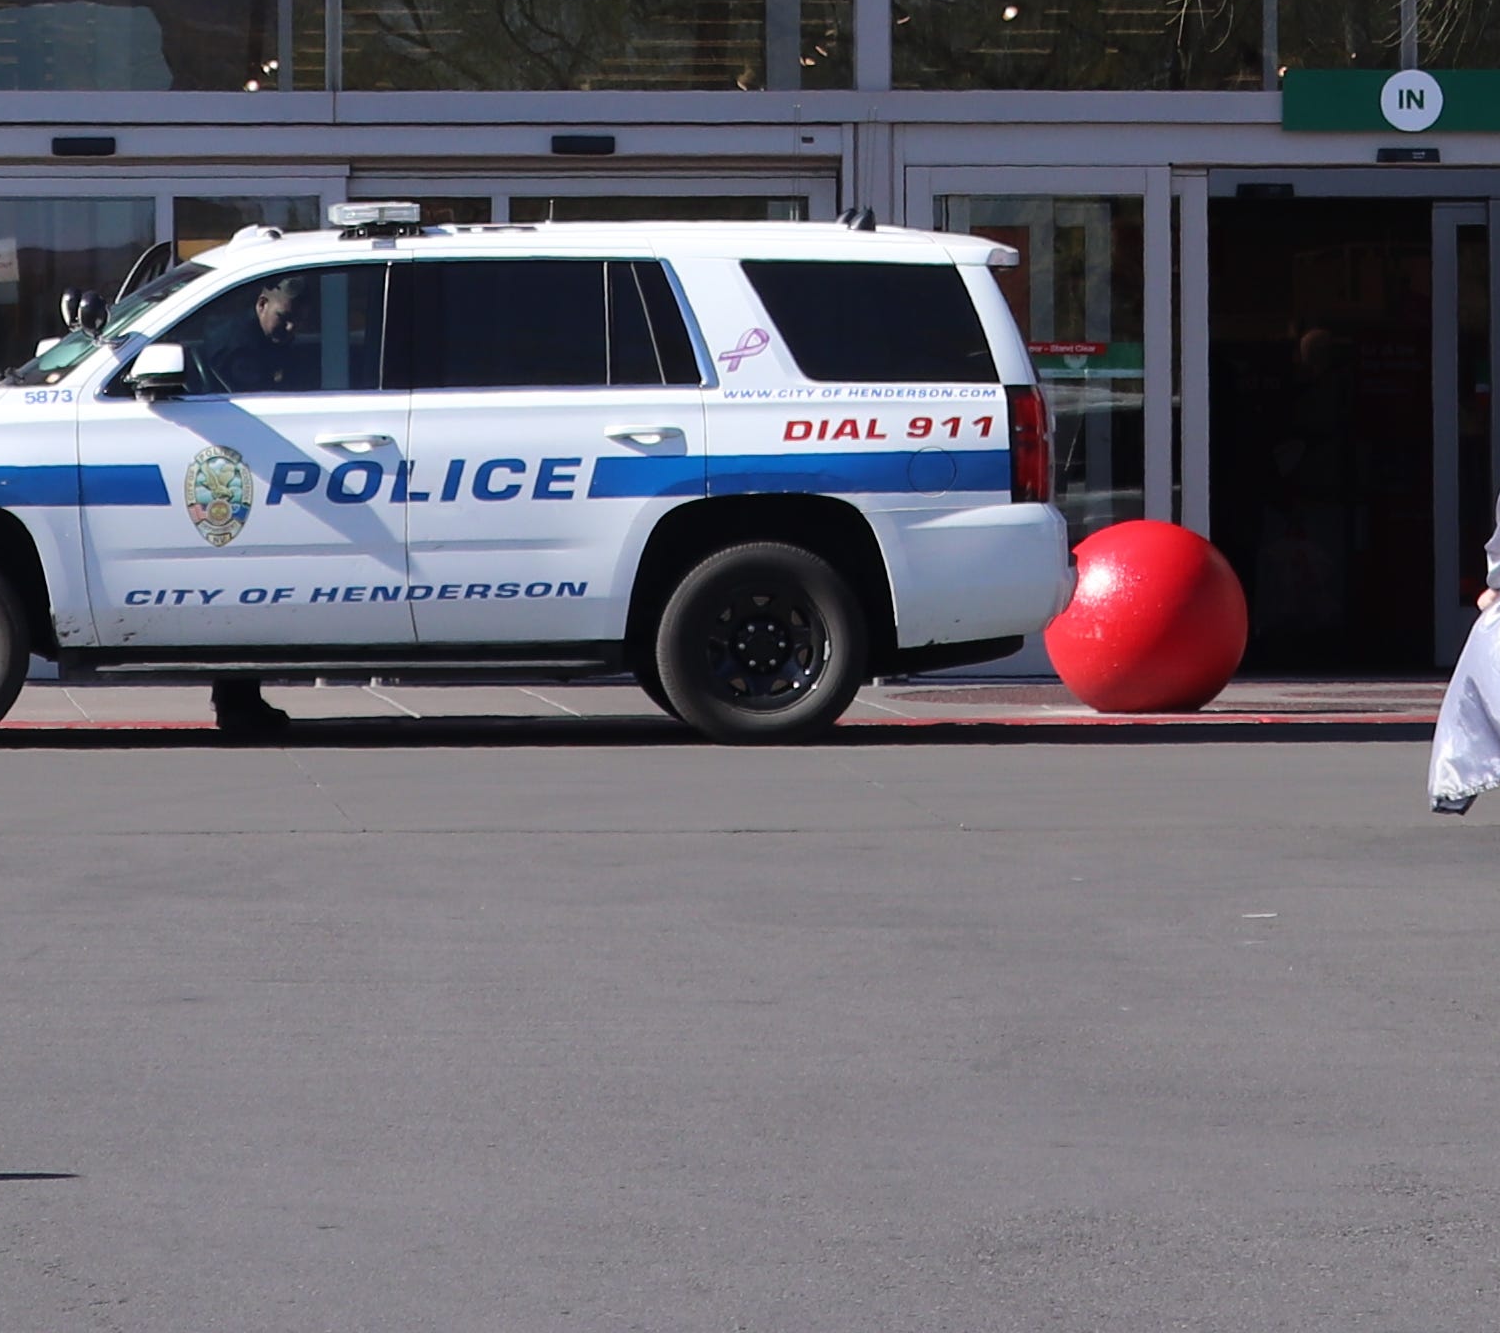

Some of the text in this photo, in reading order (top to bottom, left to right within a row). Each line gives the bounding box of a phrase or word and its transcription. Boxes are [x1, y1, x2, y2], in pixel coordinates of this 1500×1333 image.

[1398, 89, 1424, 110] IN
[25, 389, 73, 404] 5873
[825, 389, 842, 398] OF
[783, 416, 994, 442] DIAL 911
[265, 457, 583, 506] POLICE
[124, 582, 589, 607] CITY OF HENDERSON
